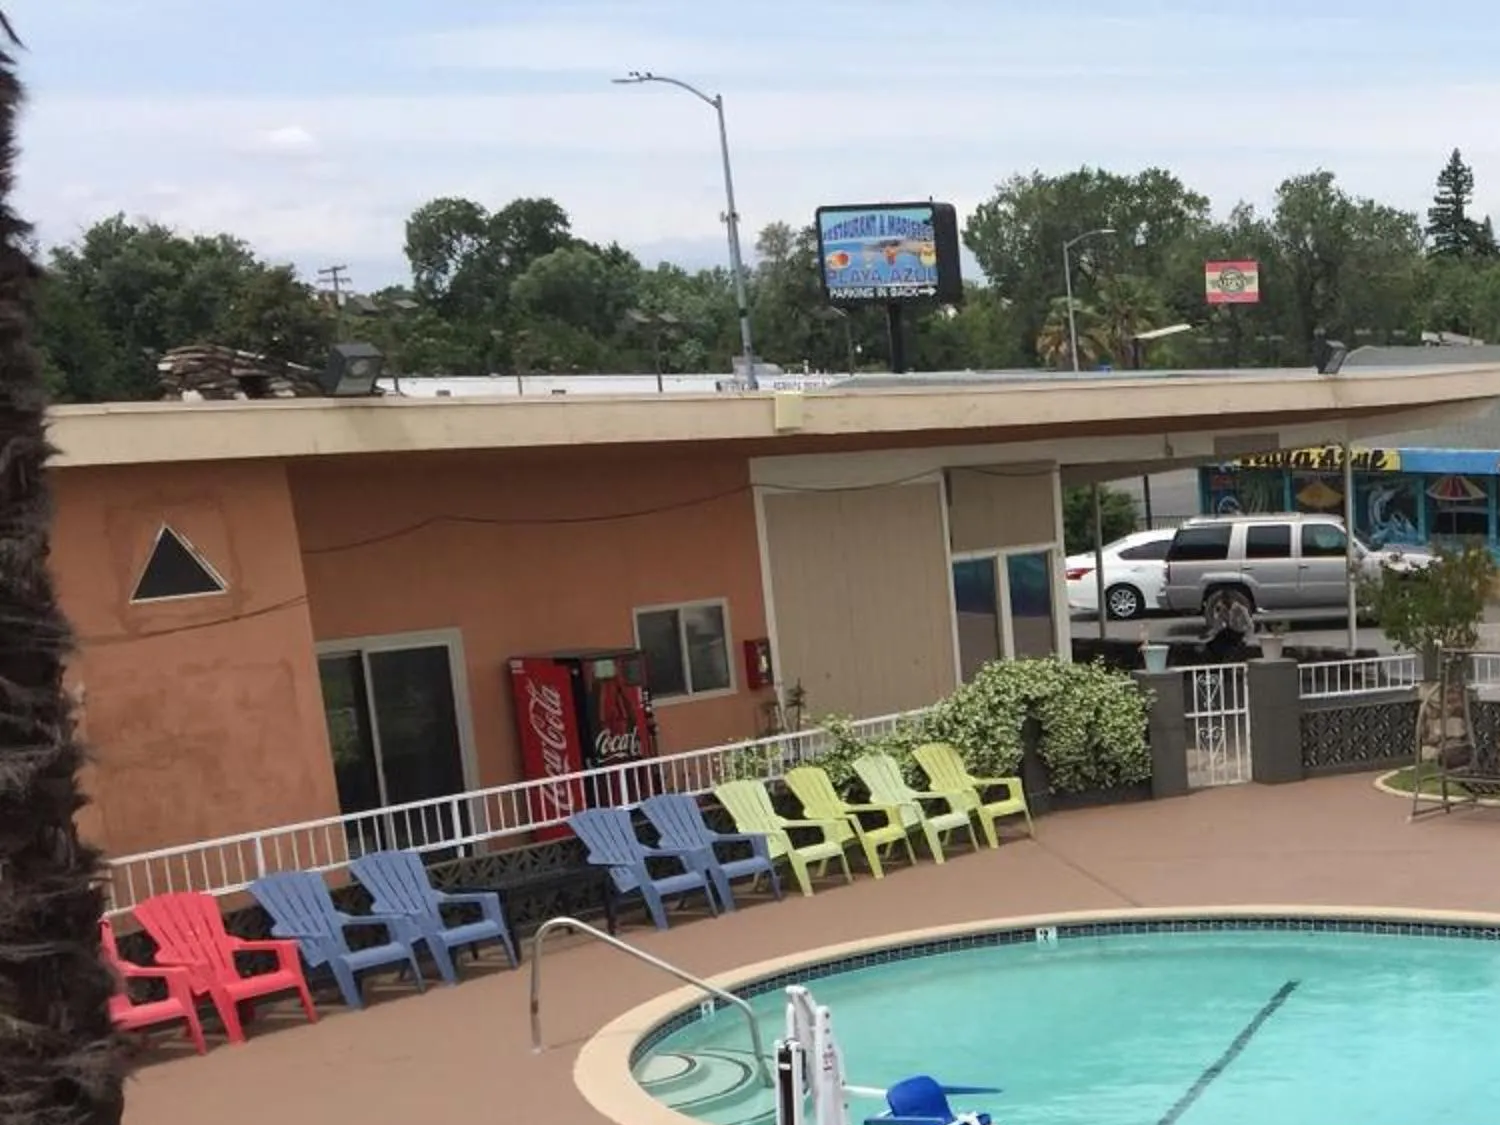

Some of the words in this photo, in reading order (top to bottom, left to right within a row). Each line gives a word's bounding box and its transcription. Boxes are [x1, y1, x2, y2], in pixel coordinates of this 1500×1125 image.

[827, 268, 882, 285] PLAYA
[890, 267, 937, 282] AZUL
[829, 287, 875, 299] PARKING
[877, 287, 889, 297] IN
[890, 286, 919, 297] BACK
